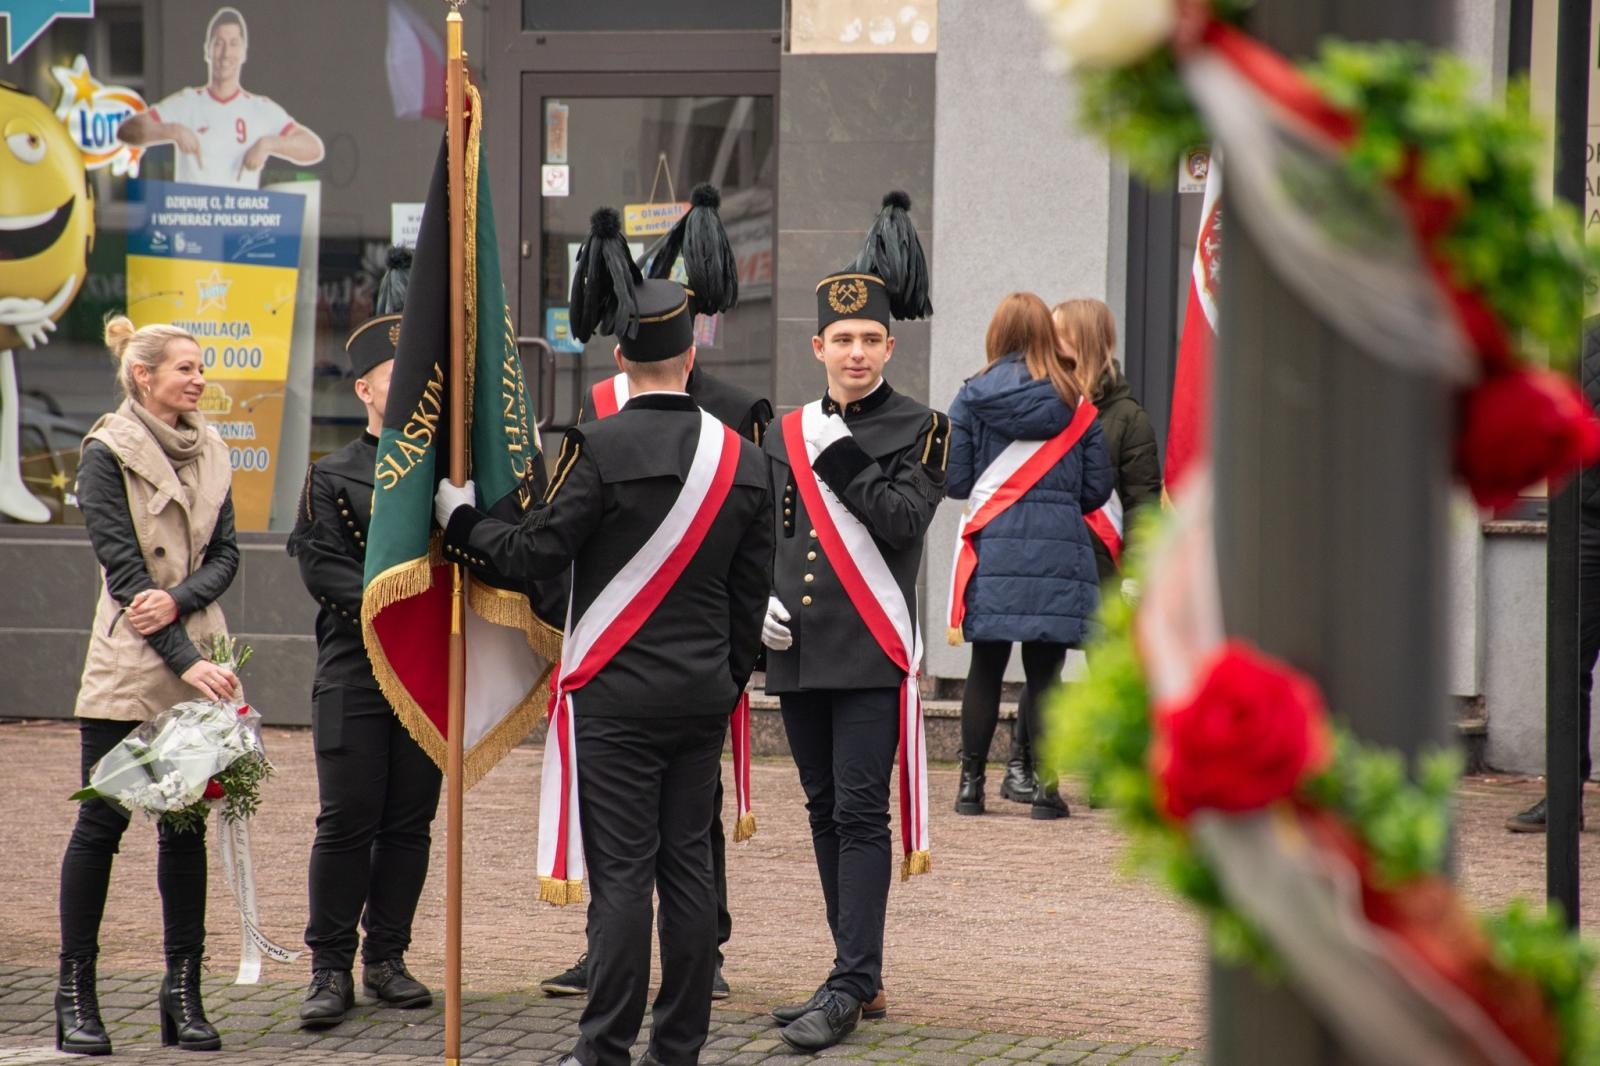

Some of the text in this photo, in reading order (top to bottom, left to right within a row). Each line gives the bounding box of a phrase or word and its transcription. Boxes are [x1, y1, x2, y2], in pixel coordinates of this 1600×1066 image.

[80, 108, 131, 147] LOT
[235, 117, 247, 143] 9
[237, 196, 269, 210] GRASZ
[159, 213, 212, 226] WSPIERASZ
[214, 214, 248, 226] POLSKI
[250, 214, 281, 226] SPORT
[172, 322, 251, 340] UMULACJA
[224, 347, 262, 368] 000
[230, 448, 268, 469] 000
